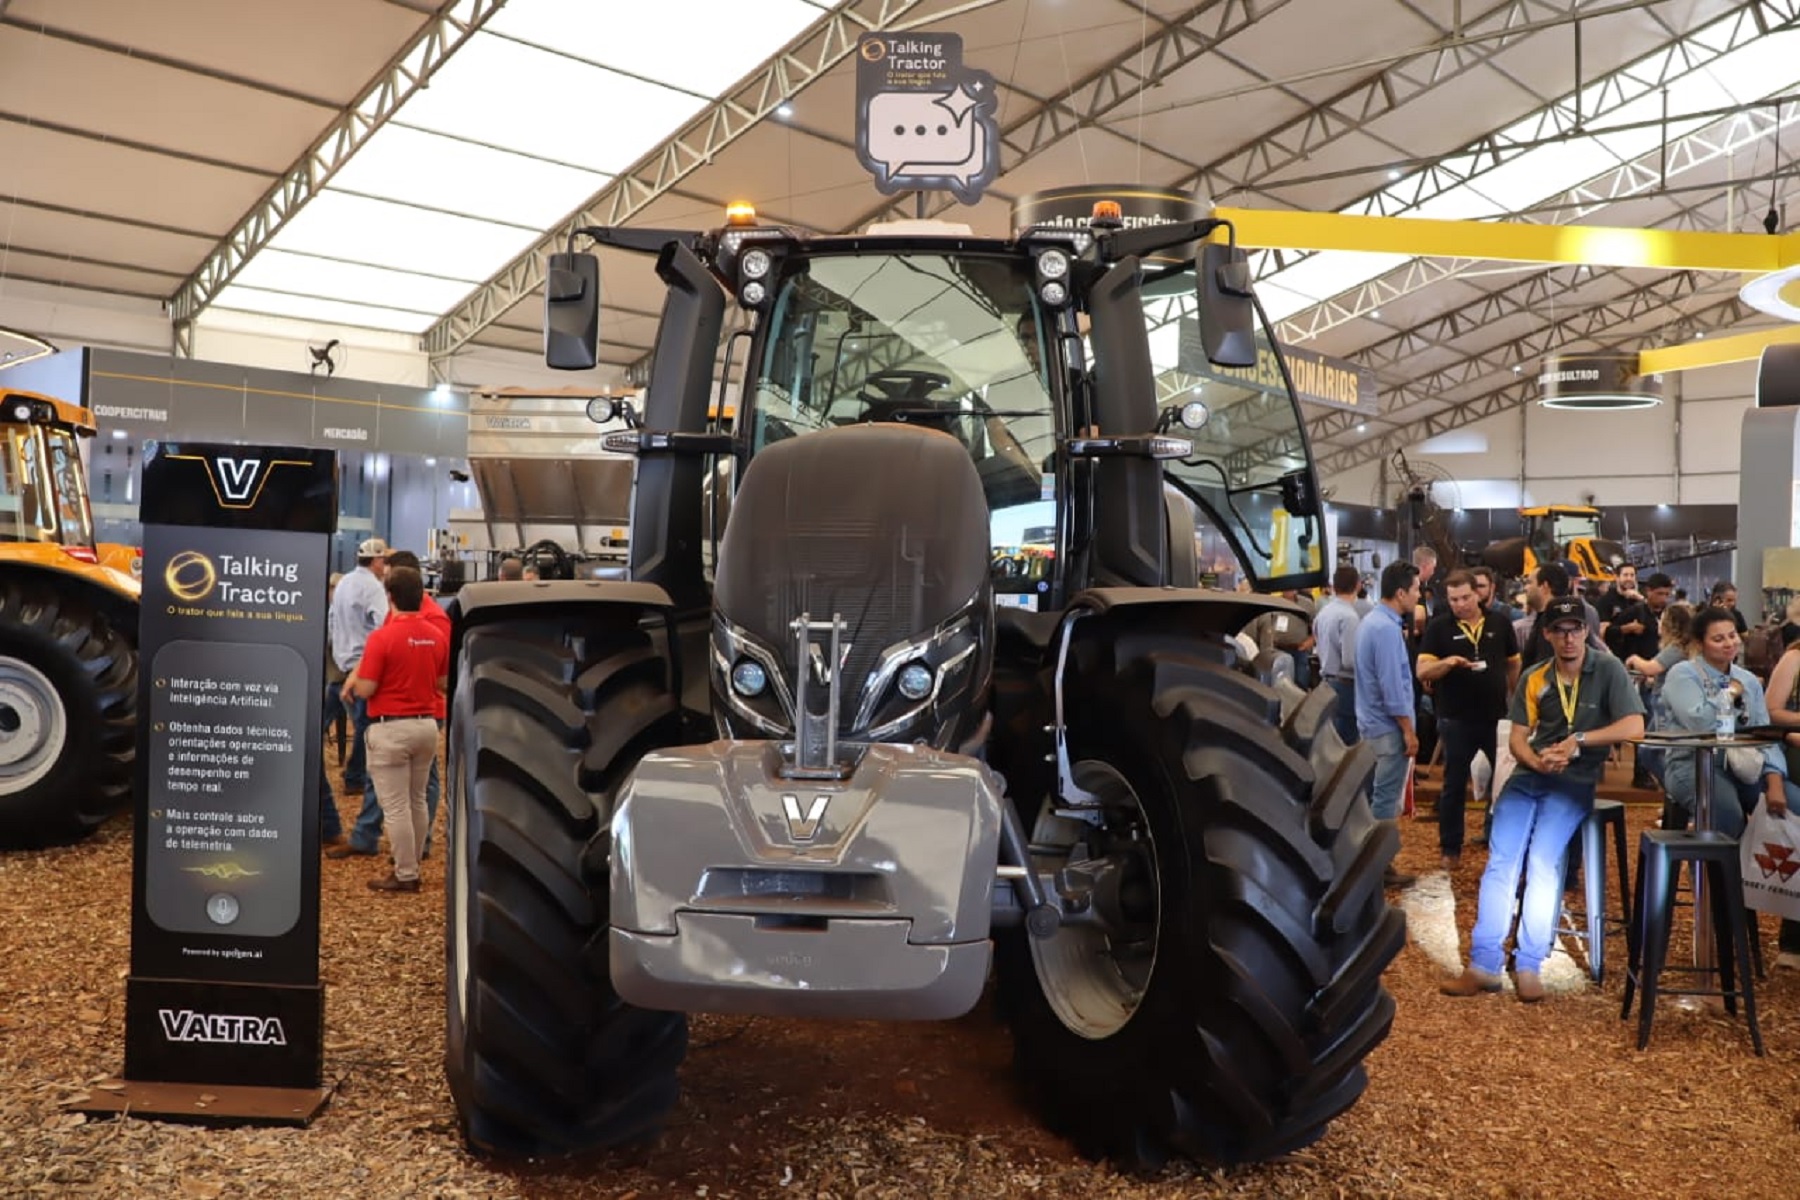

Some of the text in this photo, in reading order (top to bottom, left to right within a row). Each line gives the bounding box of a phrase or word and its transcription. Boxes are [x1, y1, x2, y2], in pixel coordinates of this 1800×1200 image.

[887, 39, 942, 57] Talking
[887, 55, 946, 70] Tractor
[94, 404, 167, 421] COOPERCITRUS
[217, 457, 260, 499] V
[219, 555, 299, 582] Talking
[218, 582, 302, 605] Tractor
[167, 605, 175, 614] O
[178, 607, 204, 616] trator
[206, 608, 224, 618] que
[247, 611, 252, 619] a
[255, 611, 272, 619] sua
[171, 677, 279, 694] Interação com voz via
[169, 692, 227, 706] Inteligência
[169, 721, 292, 739] Obtenha dados técnicos,
[168, 737, 293, 753] orientações operacionais
[168, 751, 254, 765] e informações de
[168, 765, 250, 779] desempenho em
[167, 780, 198, 793] tempo
[166, 808, 265, 824] Mais controle sobre
[166, 824, 278, 839] a operação com dados
[165, 837, 178, 848] de
[158, 1009, 288, 1045] VALTRA
